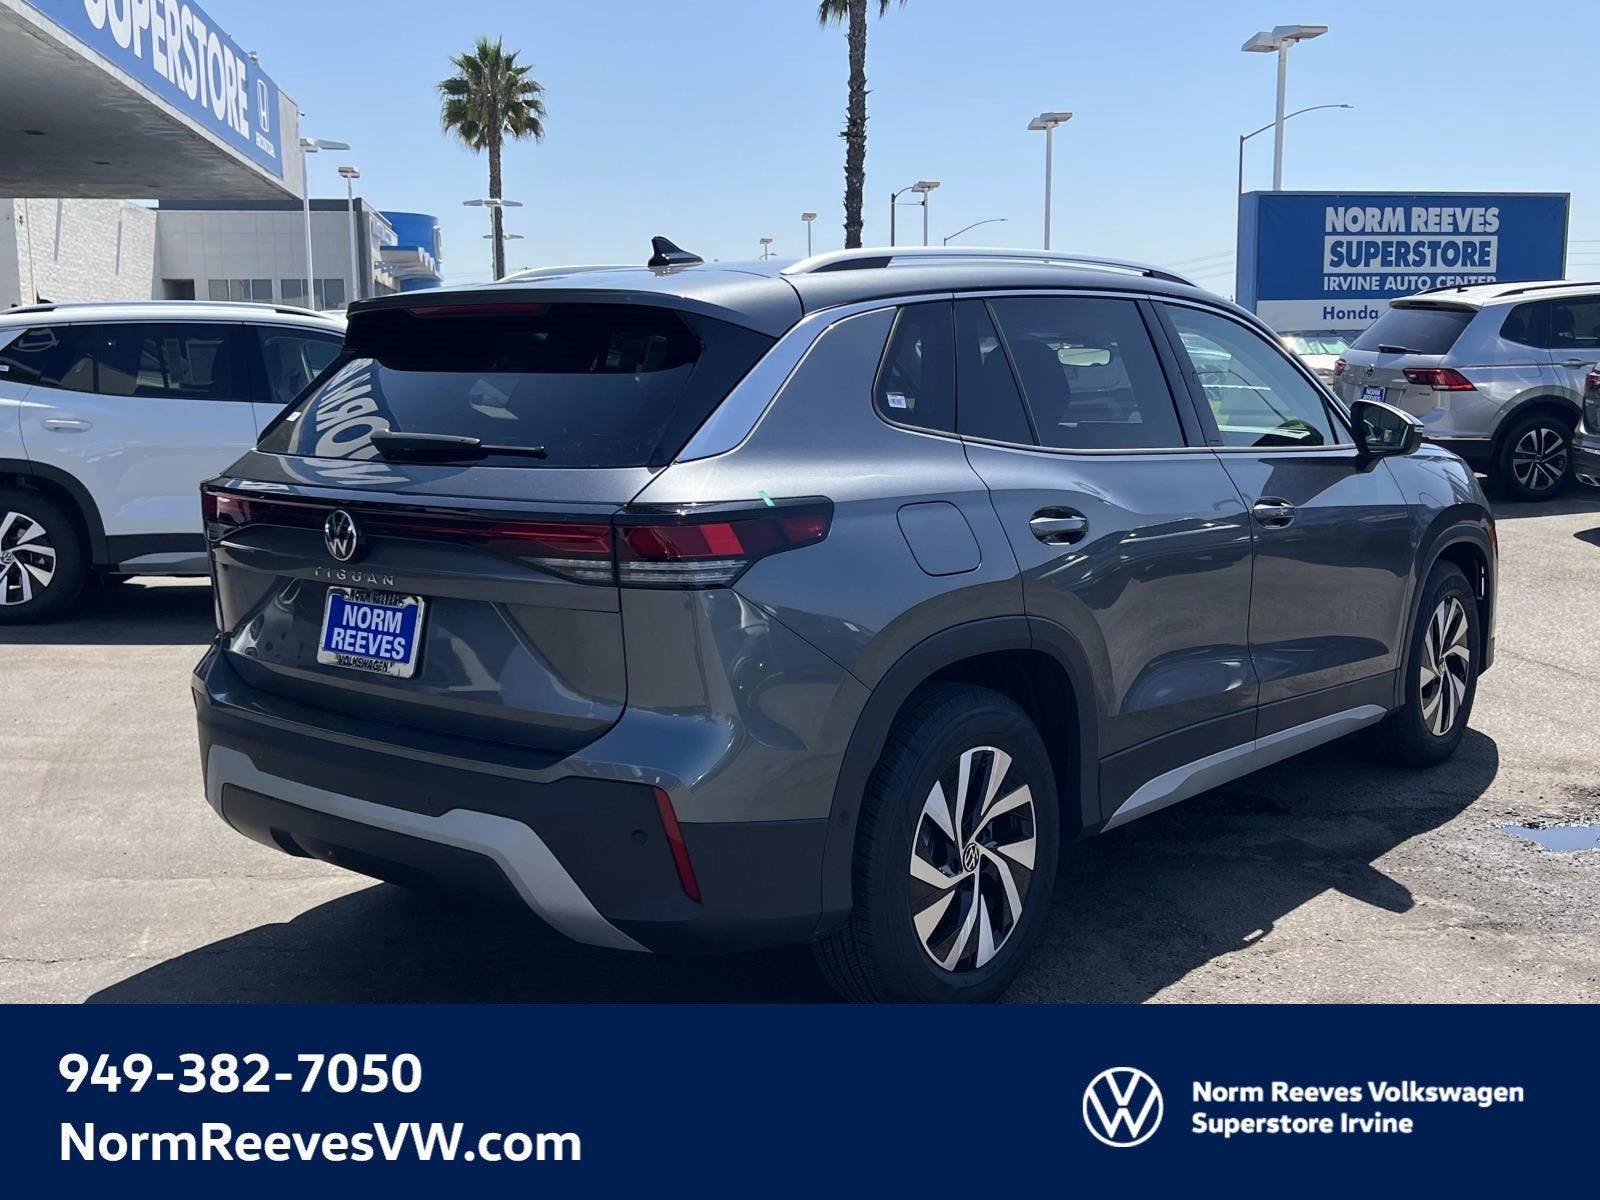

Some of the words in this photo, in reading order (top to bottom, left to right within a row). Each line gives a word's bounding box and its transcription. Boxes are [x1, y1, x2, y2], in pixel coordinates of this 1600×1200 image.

[84, 0, 250, 140] PERSTORE
[1325, 206, 1406, 233] NORM
[1411, 207, 1500, 233] REEVES
[1329, 240, 1491, 268] SUPERSTORE
[1323, 276, 1380, 291] IRVINE
[1384, 276, 1431, 291] AUTO
[1322, 305, 1379, 320] Honda
[313, 566, 395, 586] TIGUAN
[342, 604, 403, 634] NORM
[331, 627, 406, 660] REEVES
